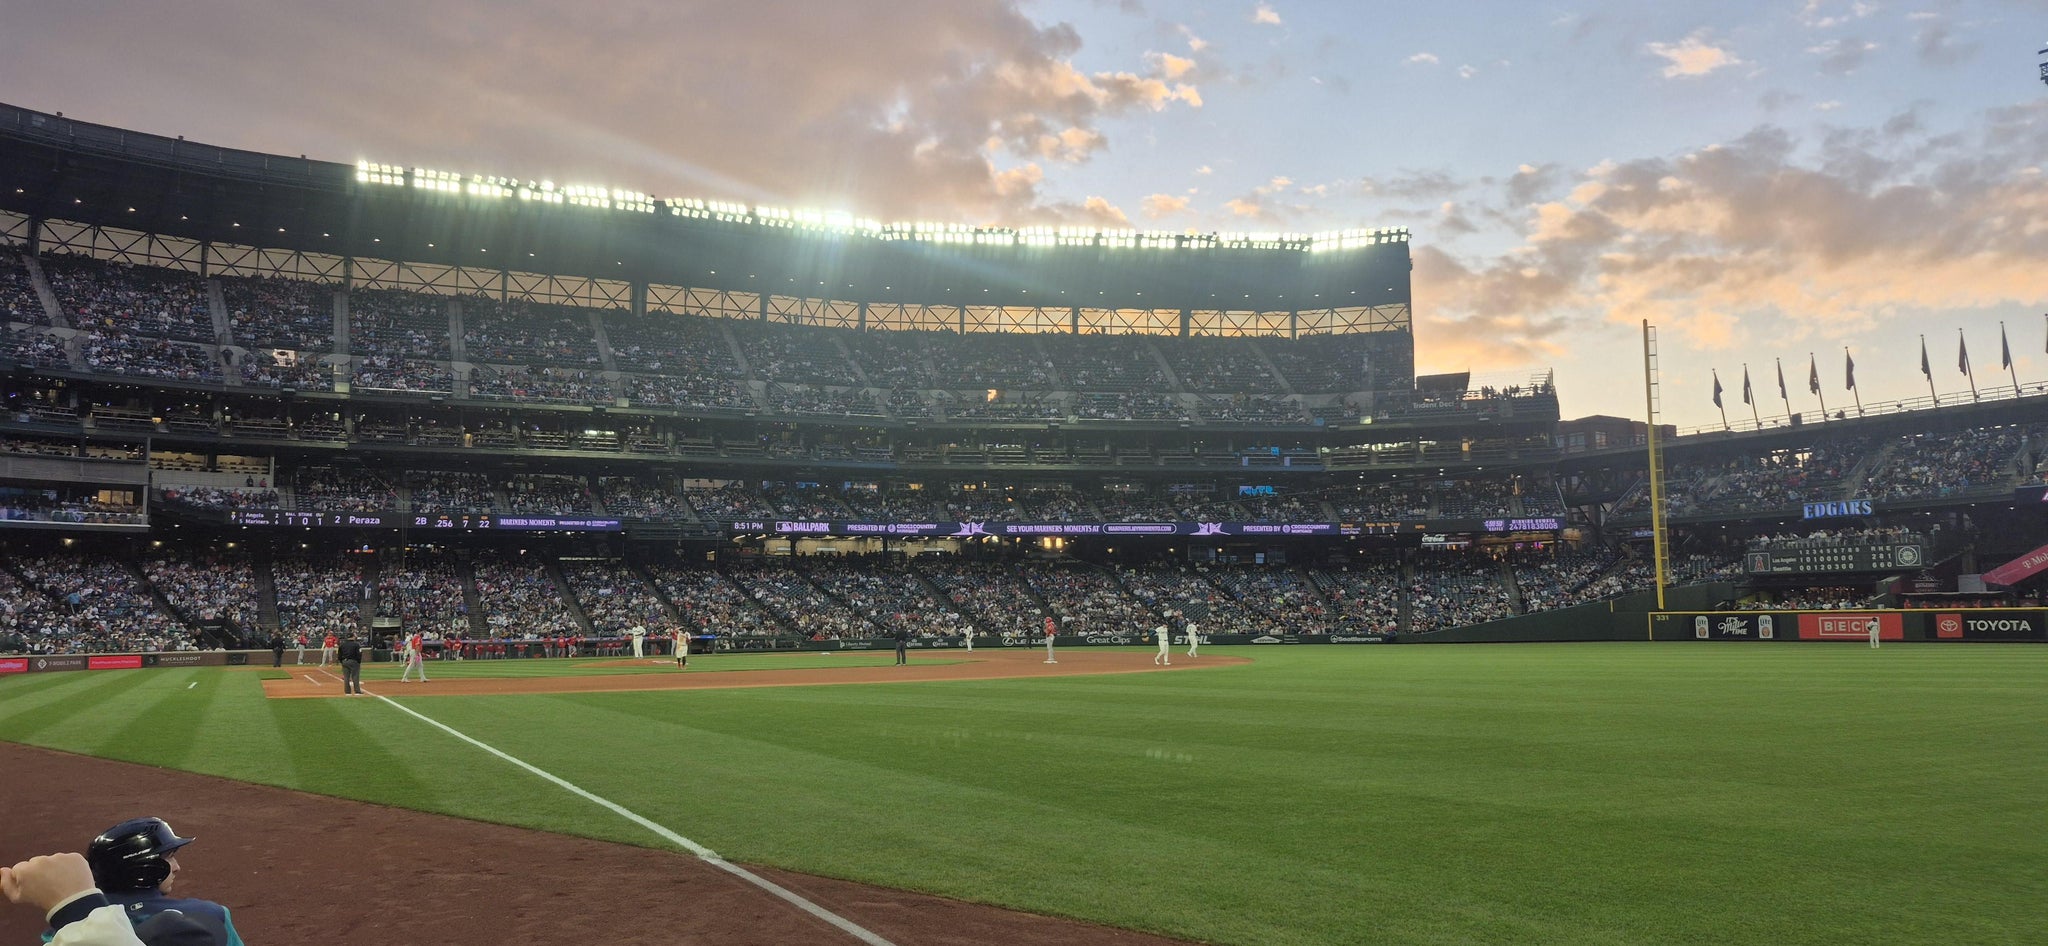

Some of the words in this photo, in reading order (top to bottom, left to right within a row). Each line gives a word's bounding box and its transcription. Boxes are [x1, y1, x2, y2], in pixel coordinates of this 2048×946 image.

[1804, 500, 1872, 520] EDGARS
[302, 517, 308, 525] 0
[350, 516, 380, 524] Peraza
[793, 522, 829, 532] BALLPARK
[2022, 560, 2031, 569] T
[1718, 620, 1748, 634] Miller
[1968, 620, 2031, 631] TOYOTA
[1086, 636, 1109, 644] Great
[1110, 636, 1131, 645] Clips
[1174, 636, 1211, 644] STHL
